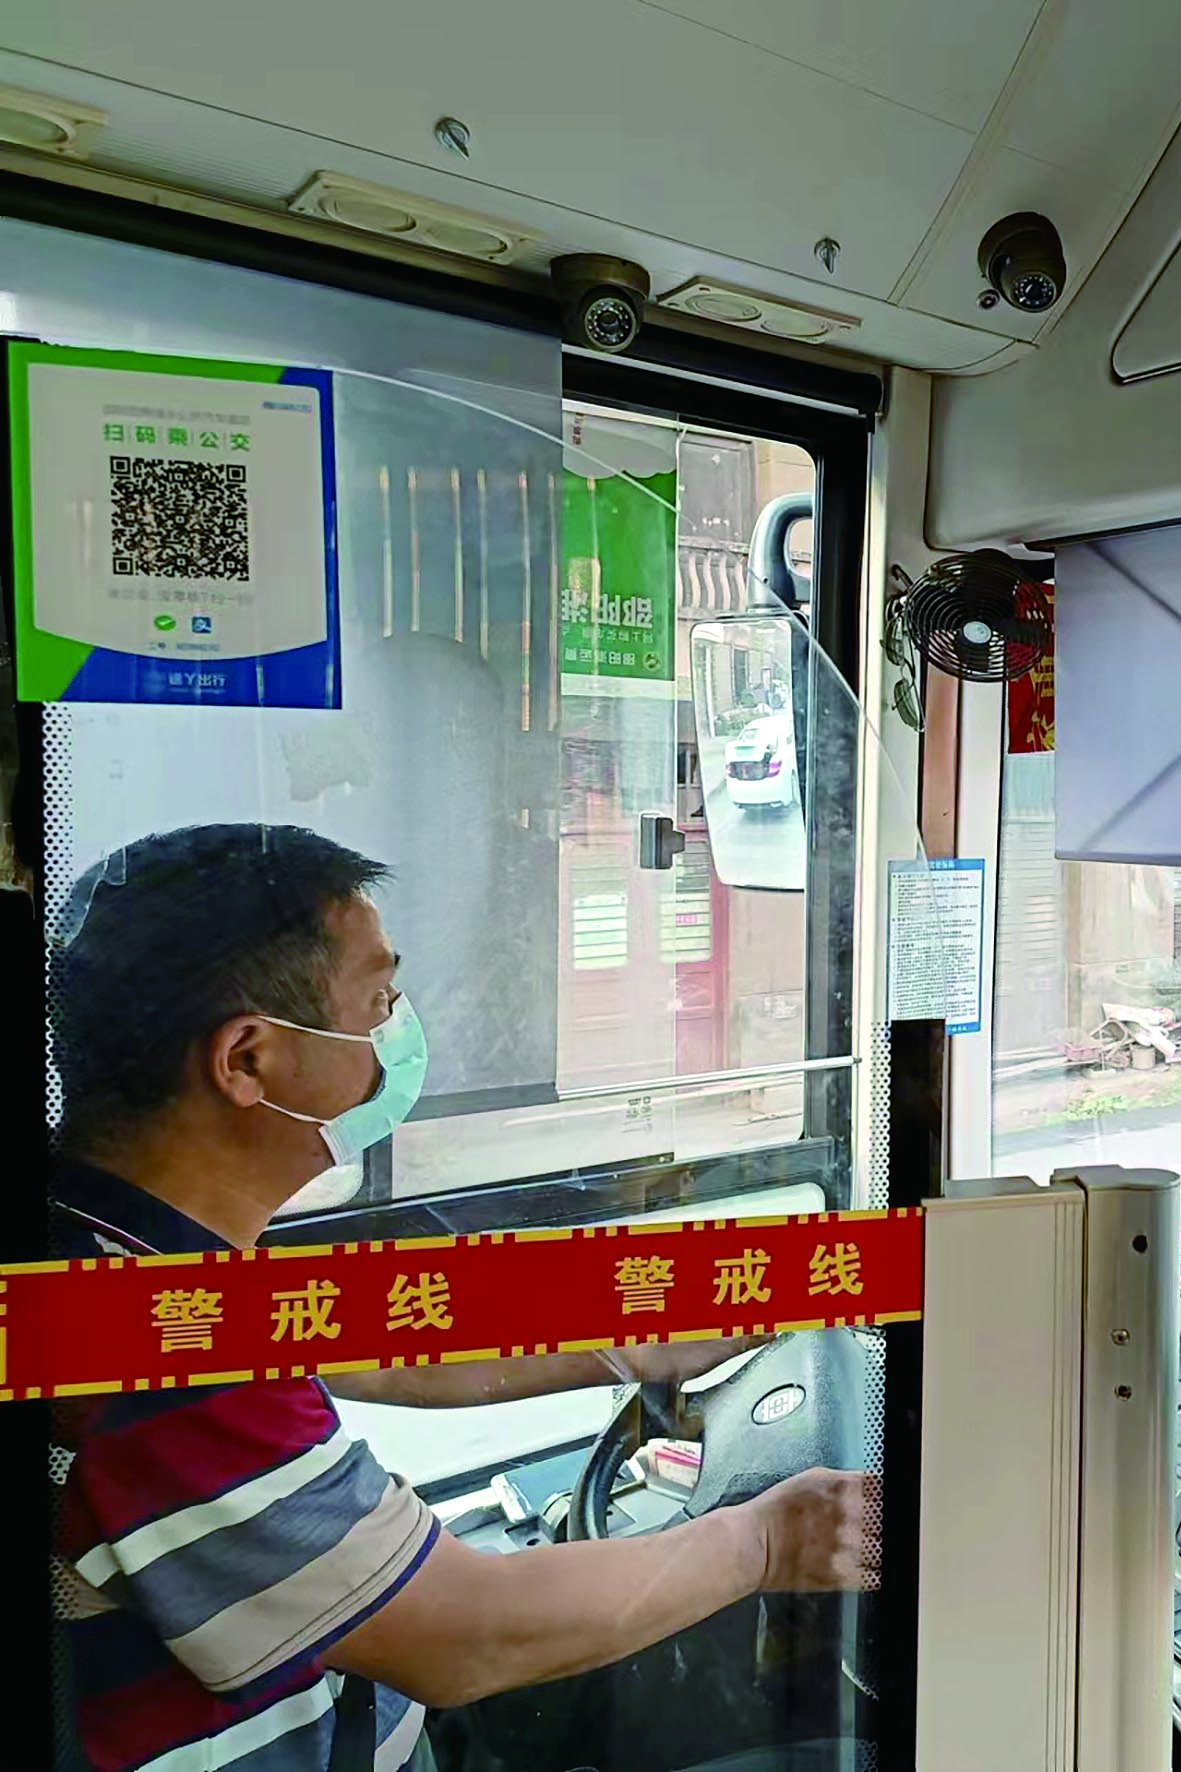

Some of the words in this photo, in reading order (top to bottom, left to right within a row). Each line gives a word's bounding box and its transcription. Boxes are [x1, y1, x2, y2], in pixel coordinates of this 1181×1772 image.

[104, 423, 250, 451] 扫码乘公交
[151, 1272, 454, 1353] 警戒线
[614, 1242, 864, 1315] 警戒线
